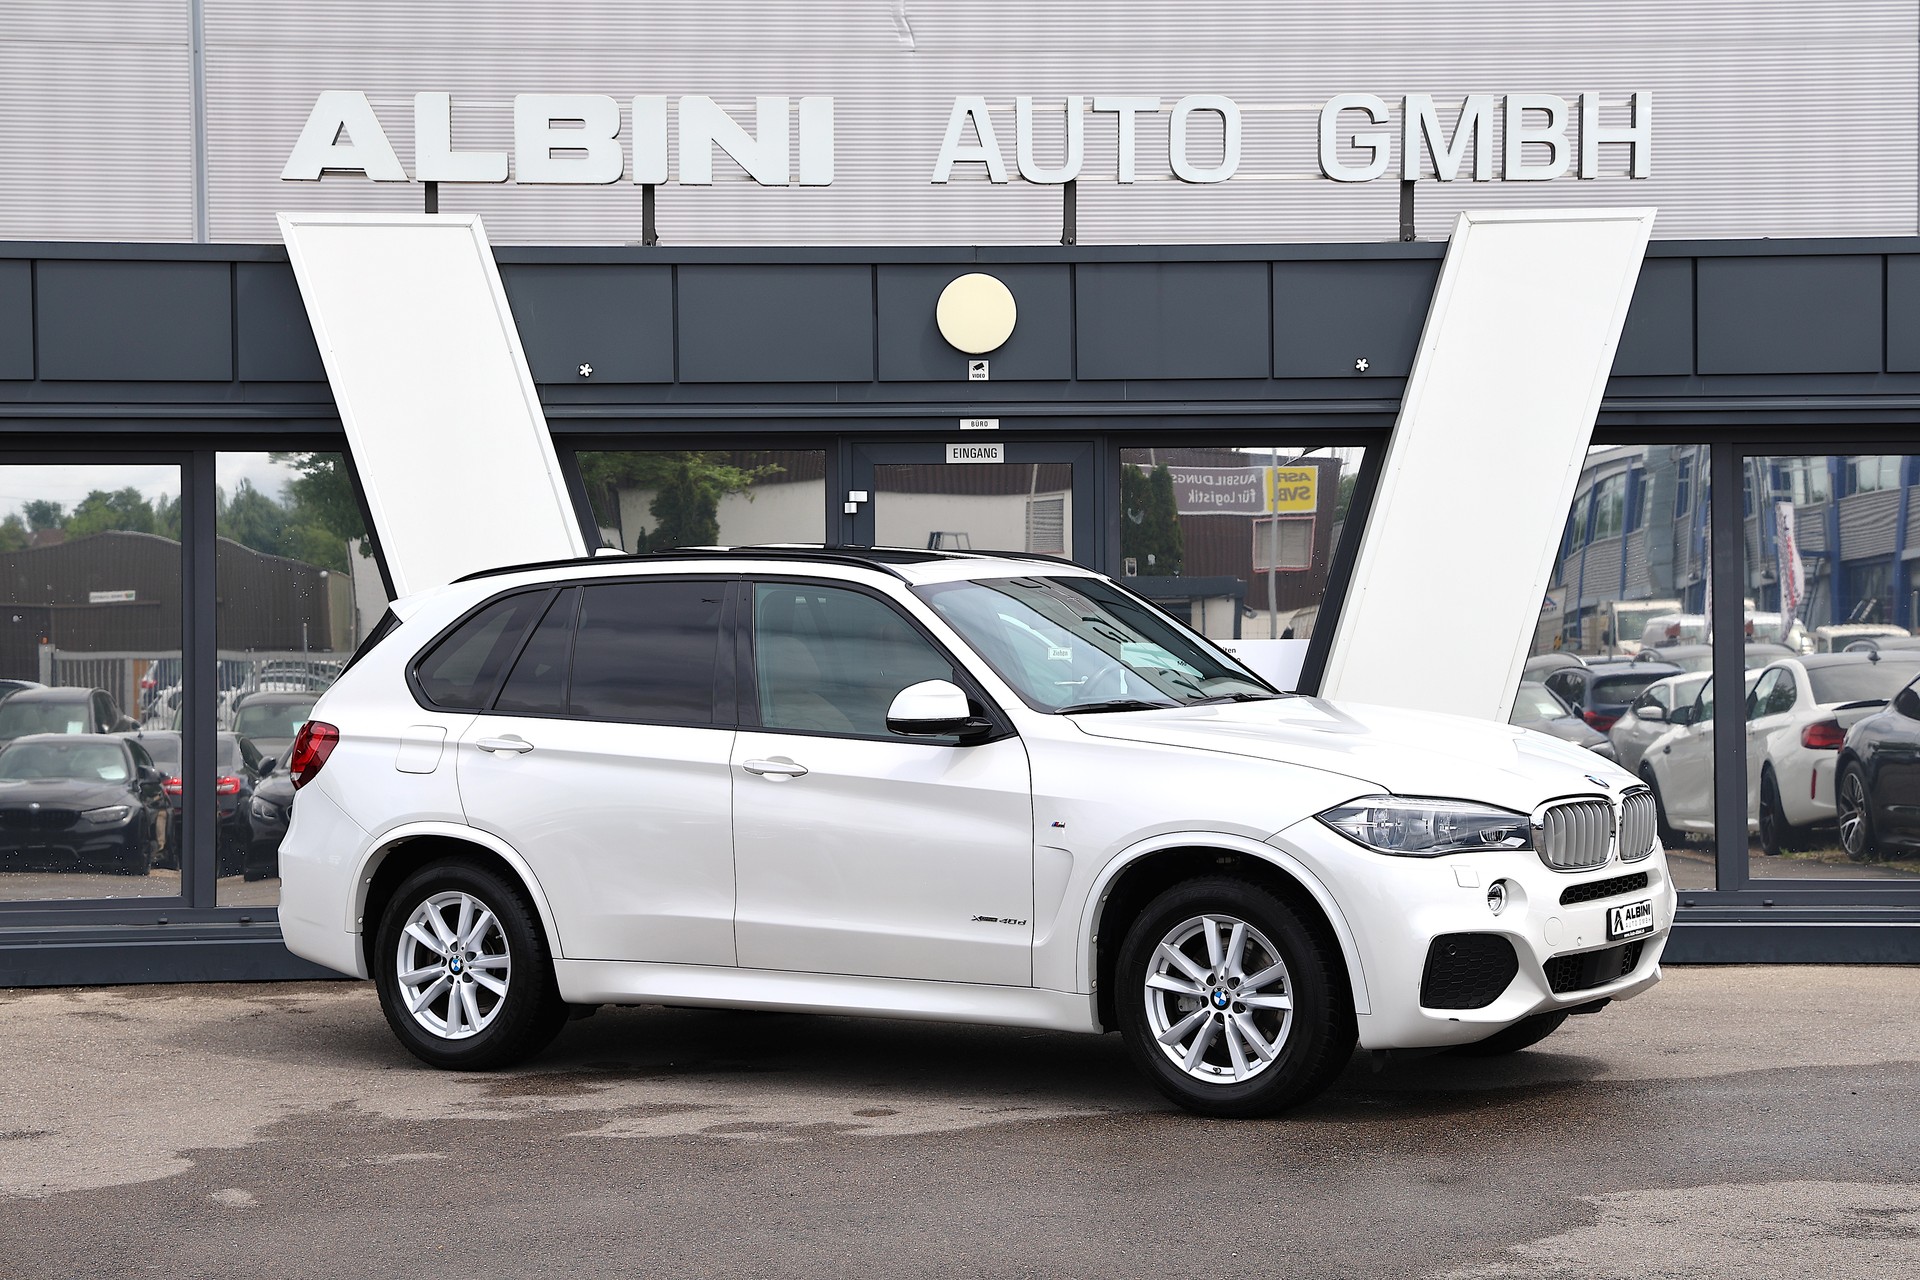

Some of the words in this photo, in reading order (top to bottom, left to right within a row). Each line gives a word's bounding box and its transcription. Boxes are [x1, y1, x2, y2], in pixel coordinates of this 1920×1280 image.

[281, 90, 834, 187] ALBINI
[931, 94, 1242, 185] AUTO
[1320, 91, 1653, 183] GMBH
[971, 420, 989, 428] BÜRO
[953, 447, 998, 459] EINGANG
[1625, 903, 1651, 921] ALBINI
